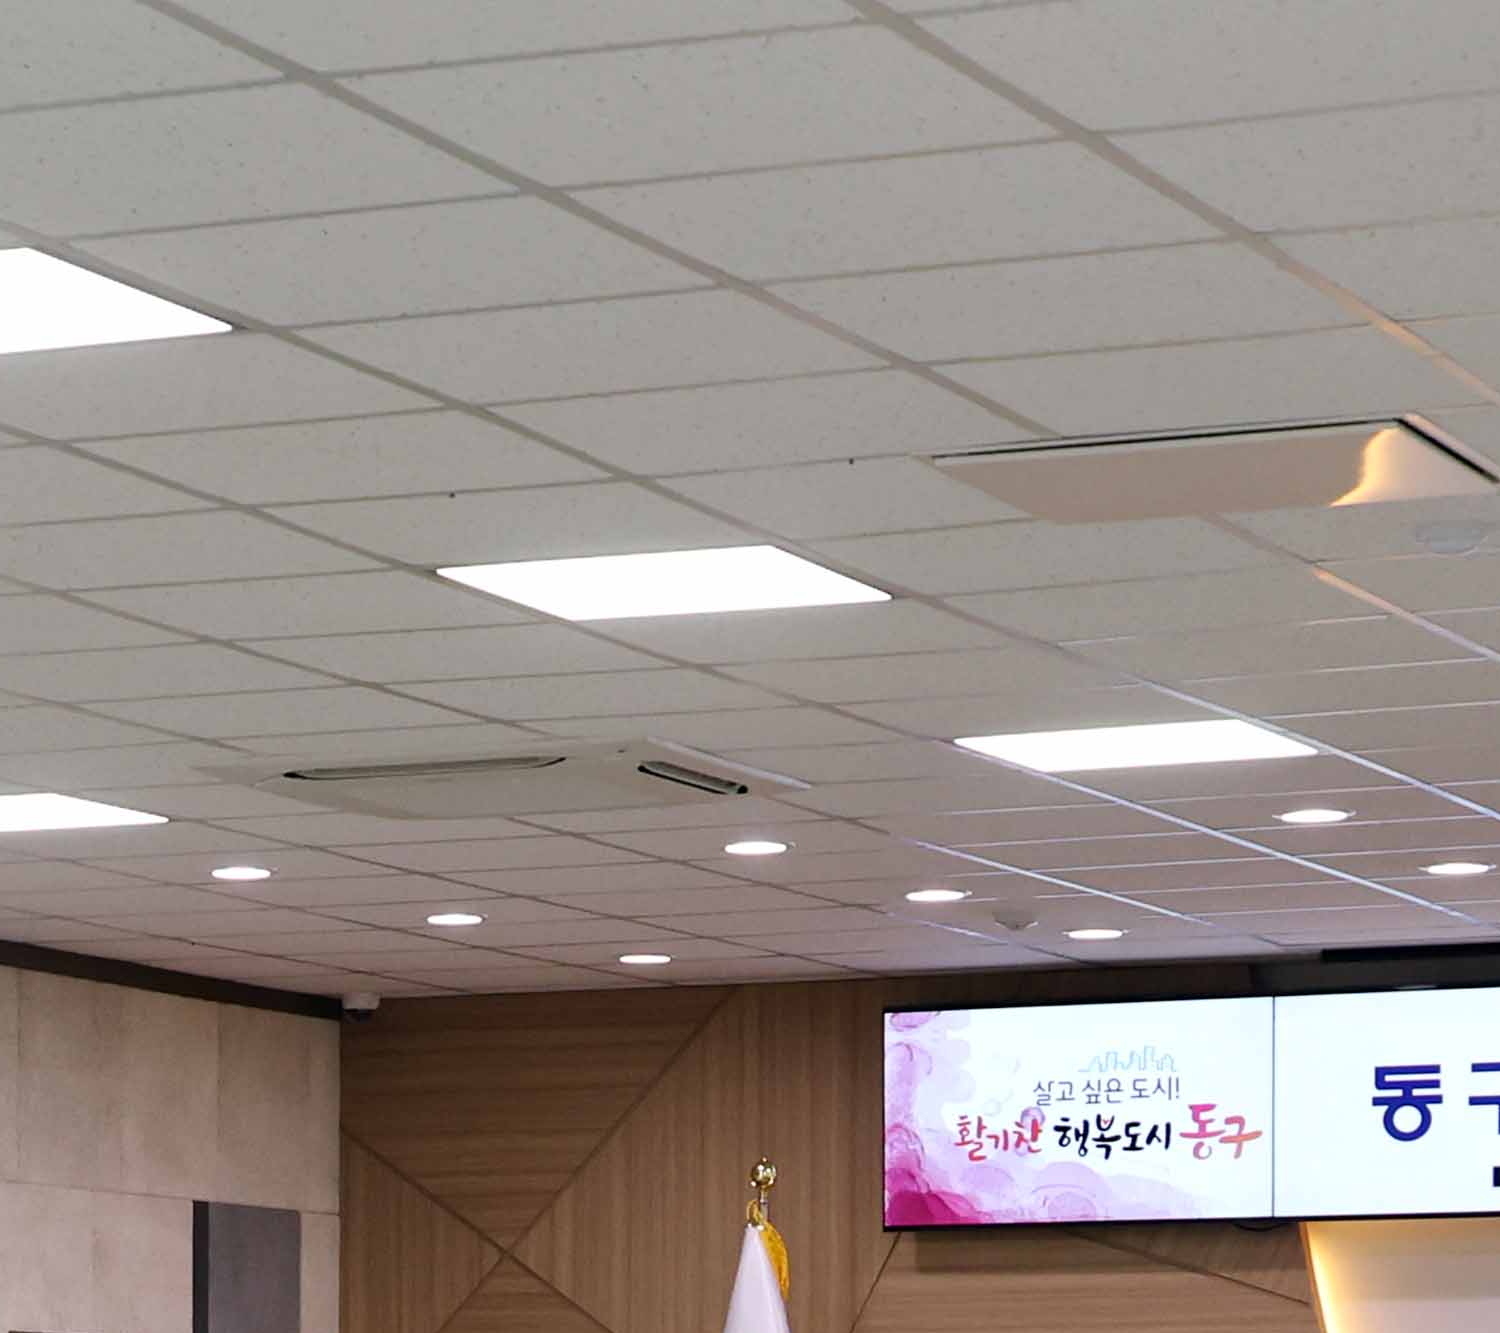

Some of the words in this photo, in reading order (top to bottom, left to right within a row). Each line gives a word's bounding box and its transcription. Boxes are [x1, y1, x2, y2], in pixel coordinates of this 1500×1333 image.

[1032, 1080, 1075, 1106] 살고
[1082, 1078, 1121, 1104] 싶은
[1132, 1077, 1180, 1100] 도시!
[954, 1112, 1043, 1161] 활기찬
[1053, 1114, 1172, 1160] 행복도시
[1179, 1103, 1263, 1160] 동구
